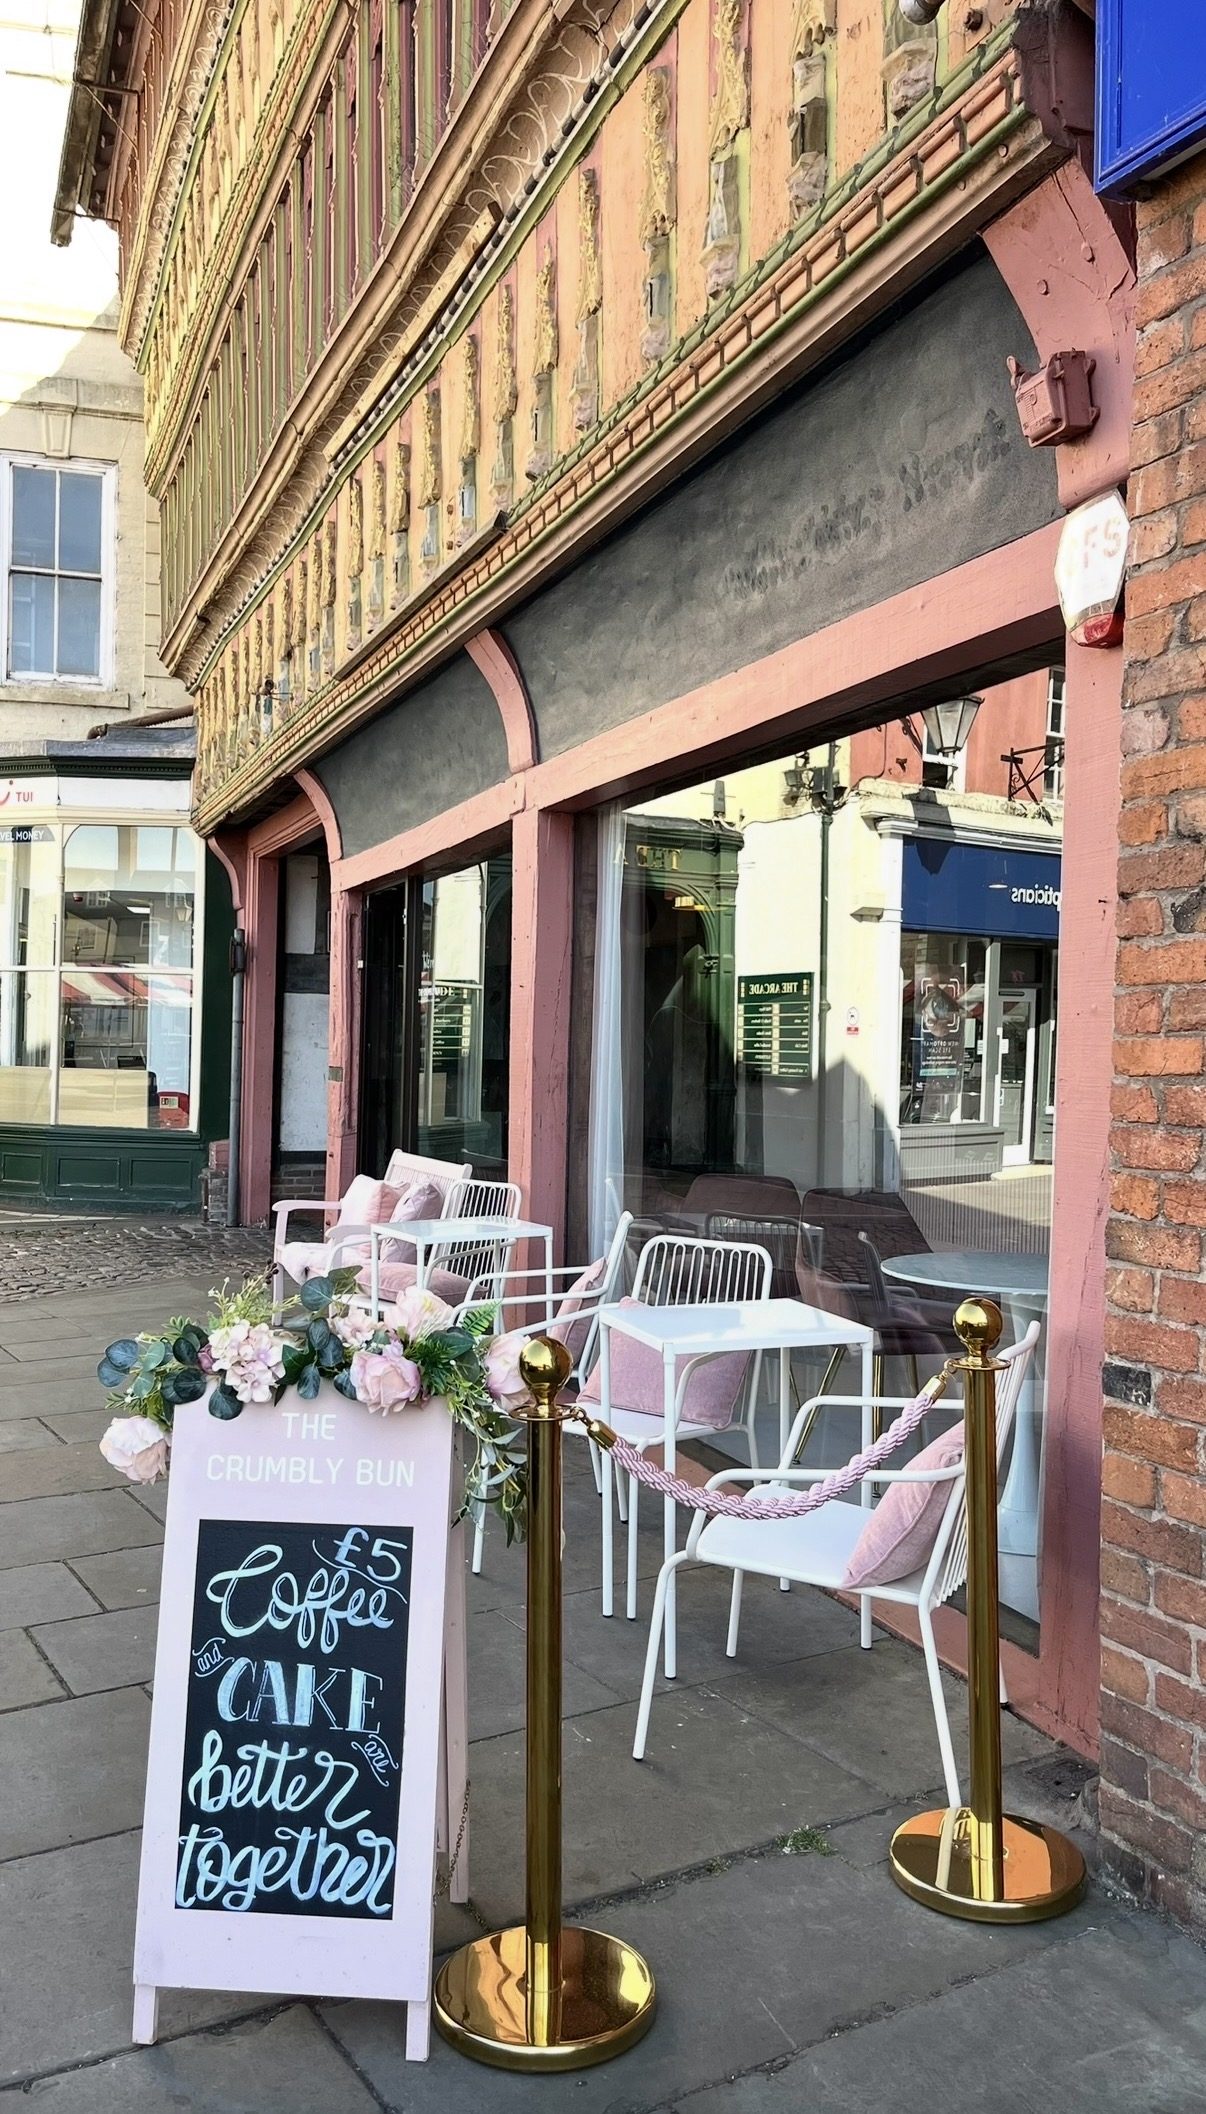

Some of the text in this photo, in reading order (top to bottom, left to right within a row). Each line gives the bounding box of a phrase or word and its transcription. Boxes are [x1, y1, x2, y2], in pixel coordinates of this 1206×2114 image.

[15, 791, 34, 803] TUI
[0, 830, 45, 842] VEL MONEY
[281, 1412, 337, 1440] THE
[206, 1454, 415, 1487] CRUMBLY BUN
[333, 1526, 408, 1582] £5
[205, 1544, 394, 1655] Coffee
[197, 1642, 225, 1673] and
[216, 1657, 384, 1734] CAKE
[363, 1740, 392, 1774] are
[187, 1728, 372, 1830] better
[176, 1823, 395, 1915] together
